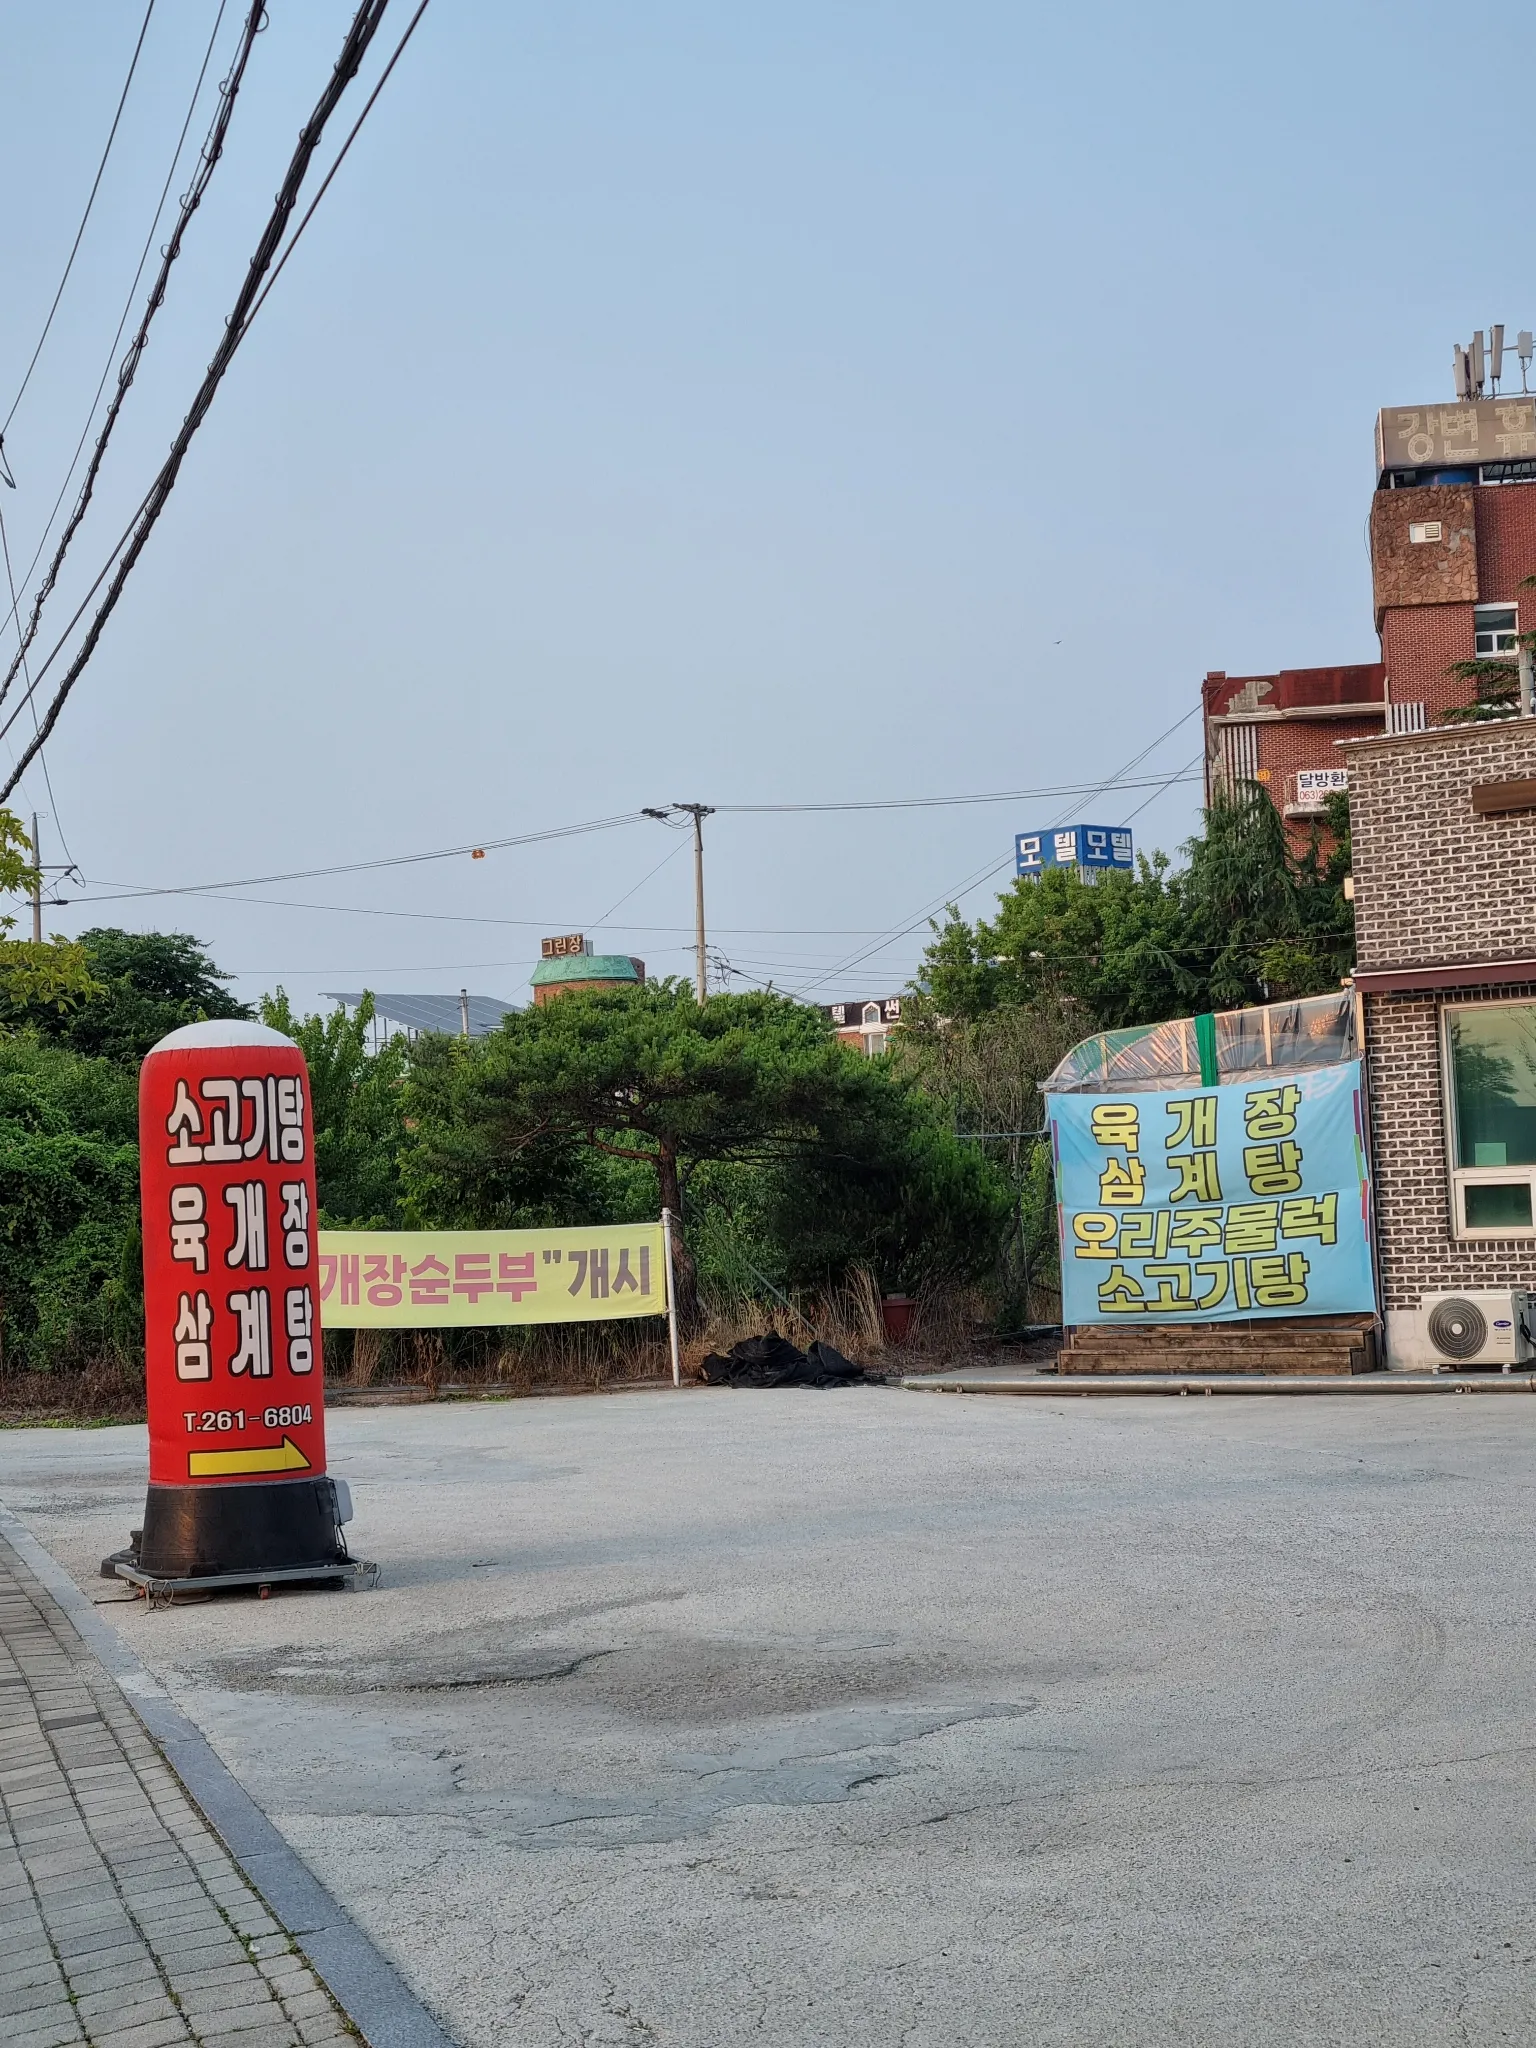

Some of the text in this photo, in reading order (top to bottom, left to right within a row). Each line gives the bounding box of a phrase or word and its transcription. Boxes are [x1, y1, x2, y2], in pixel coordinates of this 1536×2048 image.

[1397, 408, 1479, 463] 강변
[1299, 771, 1346, 788] 달방환
[1299, 789, 1334, 800] 063)26
[1087, 830, 1132, 862] 모텔
[542, 935, 582, 956] 그린장
[167, 1074, 305, 1166] 소고기탕
[1072, 1191, 1340, 1260] 오리주물럭
[1097, 1251, 1311, 1313] 소고기탕
[182, 1403, 313, 1433] T.261-6804
